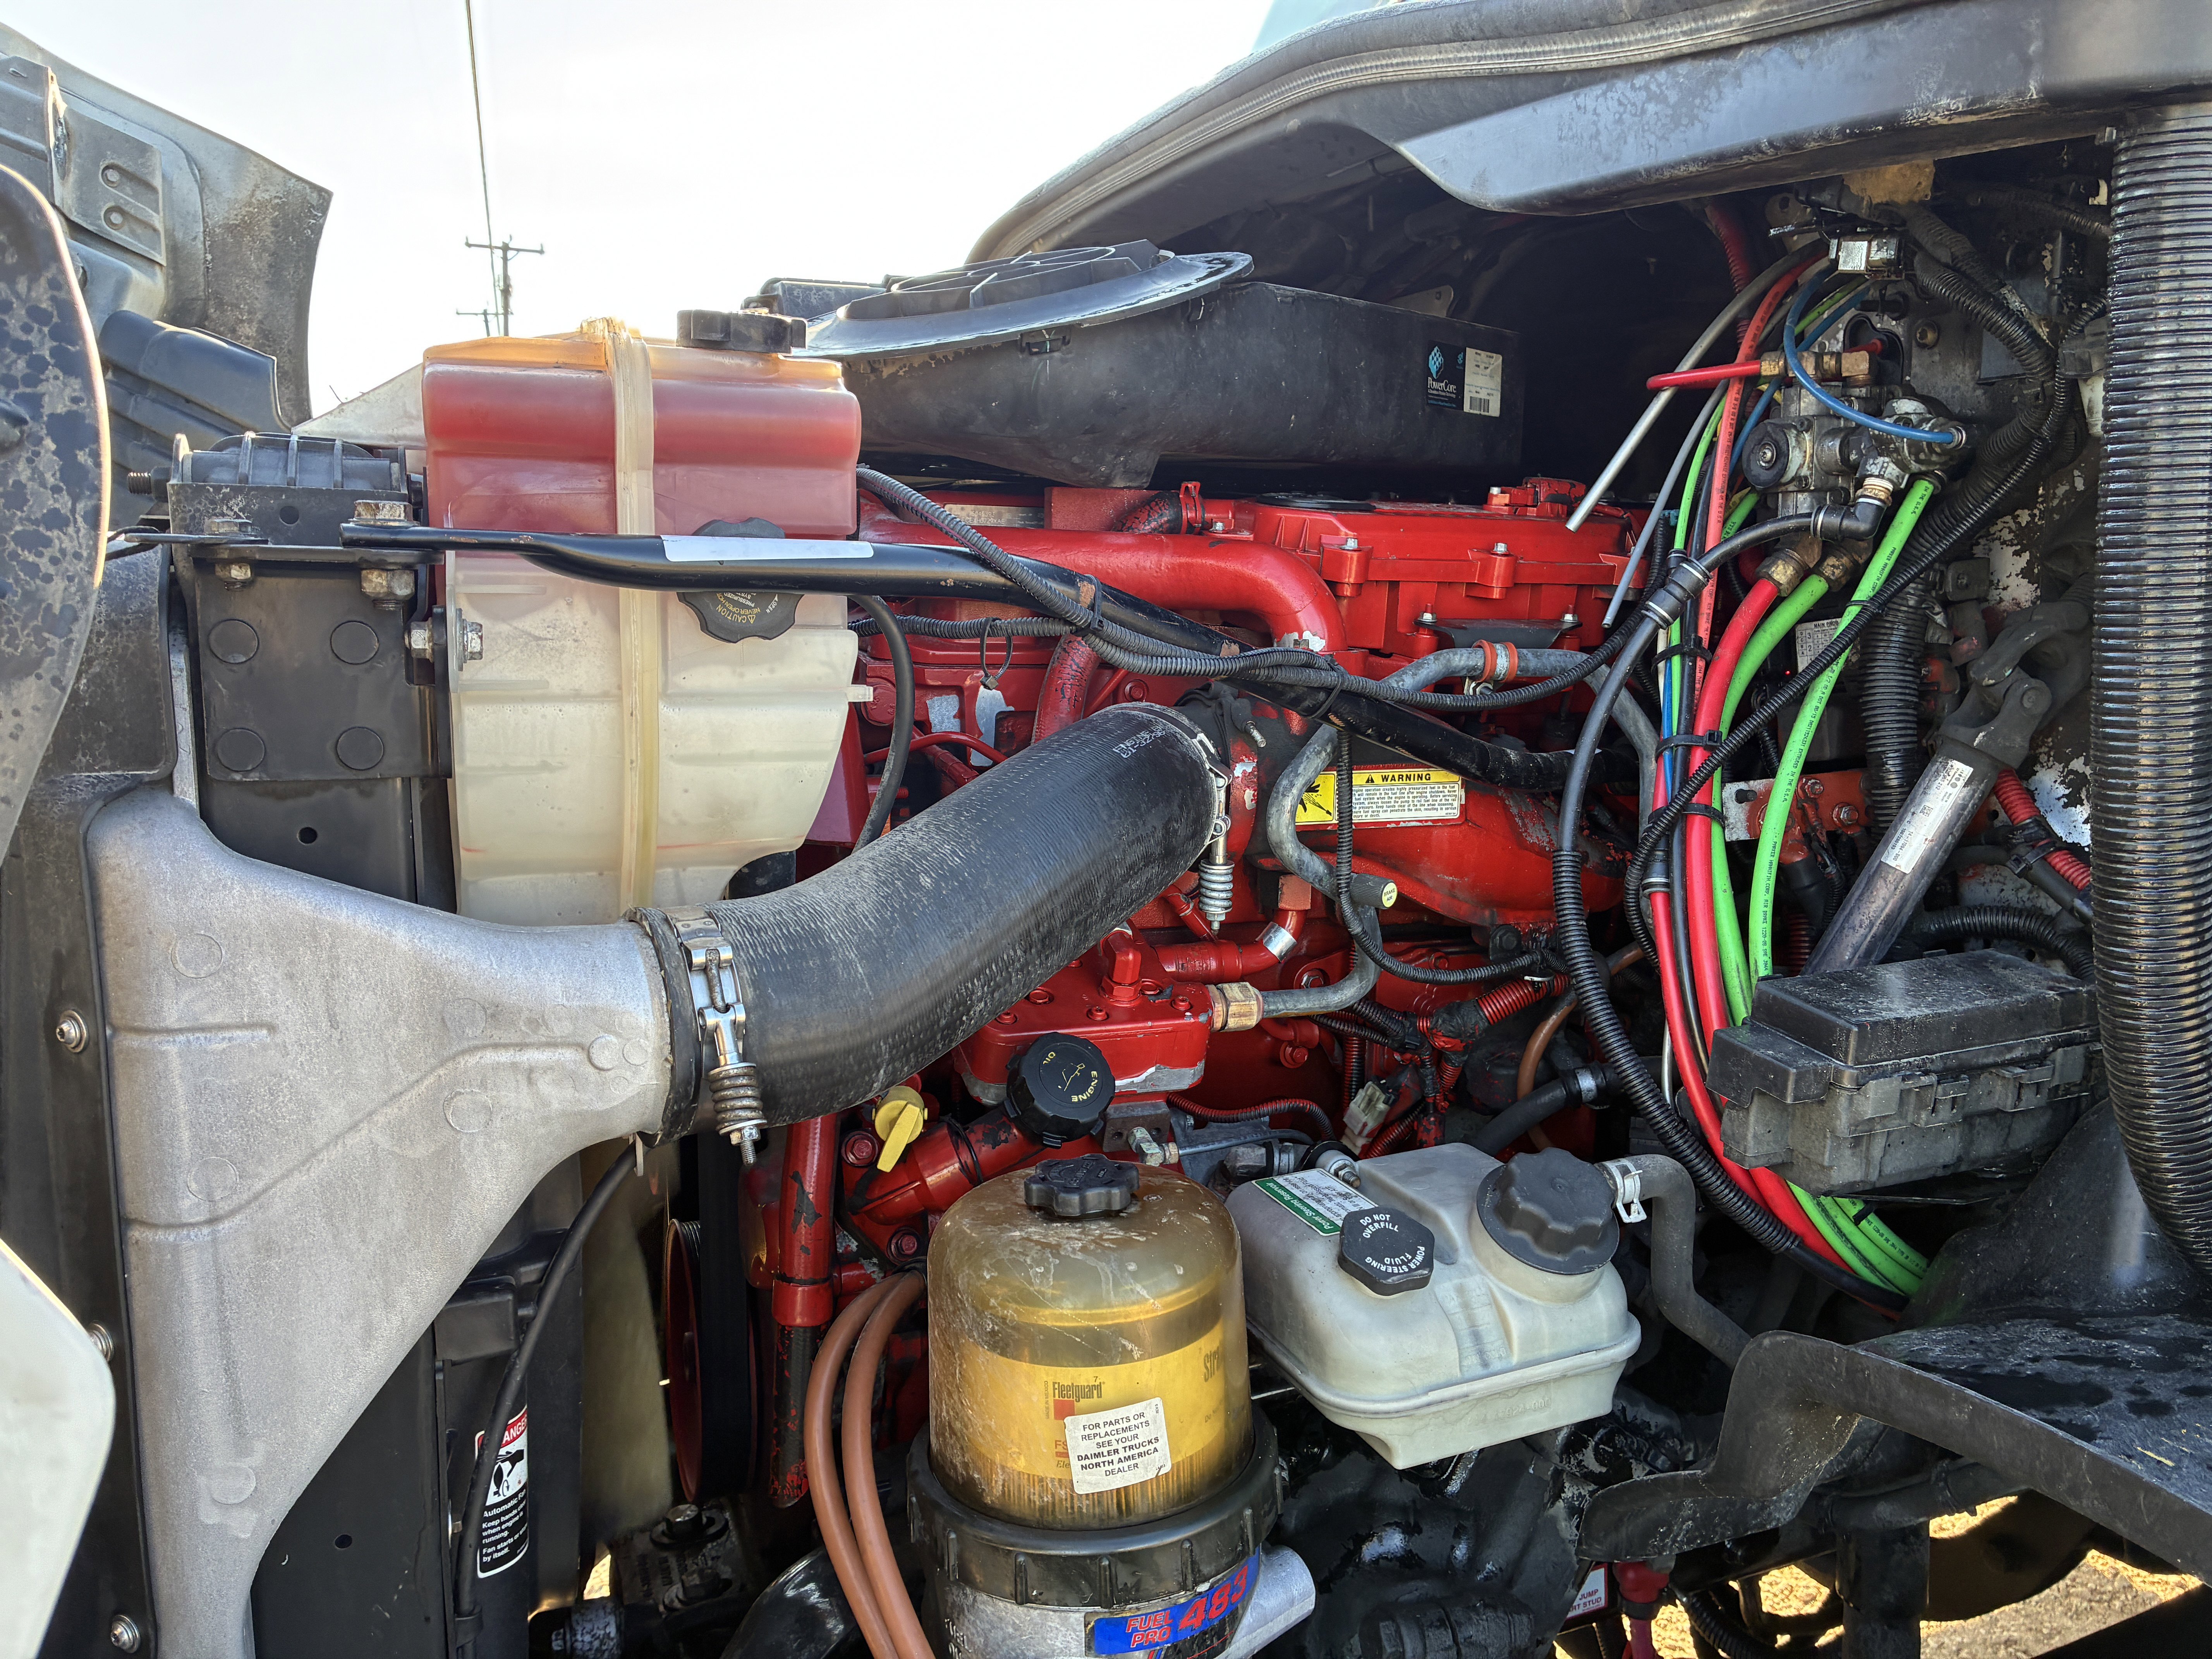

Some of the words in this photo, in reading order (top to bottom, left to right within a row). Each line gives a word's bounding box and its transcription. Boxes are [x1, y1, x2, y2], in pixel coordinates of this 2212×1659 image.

[1428, 377, 1456, 393] PowerCore
[724, 592, 755, 607] PRESSURIZED
[724, 601, 740, 613] OPEN
[716, 604, 747, 623] CAUTION
[1381, 773, 1431, 783] WARNING
[1043, 1051, 1056, 1065] OIL
[1071, 1071, 1098, 1102] ENGINE
[1266, 1182, 1291, 1200] Reservoir
[1291, 1200, 1316, 1217] Steering
[1314, 1216, 1334, 1230] Power
[1360, 1216, 1372, 1226] DO
[1362, 1222, 1398, 1238] OVERFILL
[1365, 1256, 1408, 1273] STEERING
[1384, 1253, 1412, 1265] FLUID
[1408, 1246, 1425, 1269] POWER
[1052, 1381, 1102, 1403] Fleetguard
[503, 1413, 527, 1444] ANGE
[1083, 1422, 1101, 1431] FOR
[1103, 1416, 1131, 1428] PARTS
[1133, 1412, 1146, 1420] OR
[1081, 1420, 1150, 1441] REPLACEMENTS
[1077, 1448, 1120, 1462] DAIMLER
[1122, 1436, 1159, 1453] TRUCKS
[1096, 1439, 1113, 1449] SEE
[1115, 1433, 1139, 1445] YOUR
[1081, 1458, 1114, 1471] NORTH
[1118, 1447, 1159, 1464] AMERICA
[1104, 1463, 1139, 1477] DEALER
[483, 1498, 518, 1518] Automatic
[482, 1519, 500, 1528] Keep
[501, 1508, 518, 1522] hands
[482, 1526, 500, 1536] when
[501, 1515, 519, 1529] engine
[482, 1530, 509, 1544] running.
[483, 1546, 496, 1554] Fan
[497, 1537, 514, 1549] starts
[493, 1546, 510, 1559] itself.
[1178, 1565, 1249, 1632] 483
[1579, 1589, 1599, 1601] JUMP
[1583, 1596, 1602, 1608] STUD
[1126, 1609, 1173, 1633] FUEL
[1130, 1626, 1171, 1648] PRO
